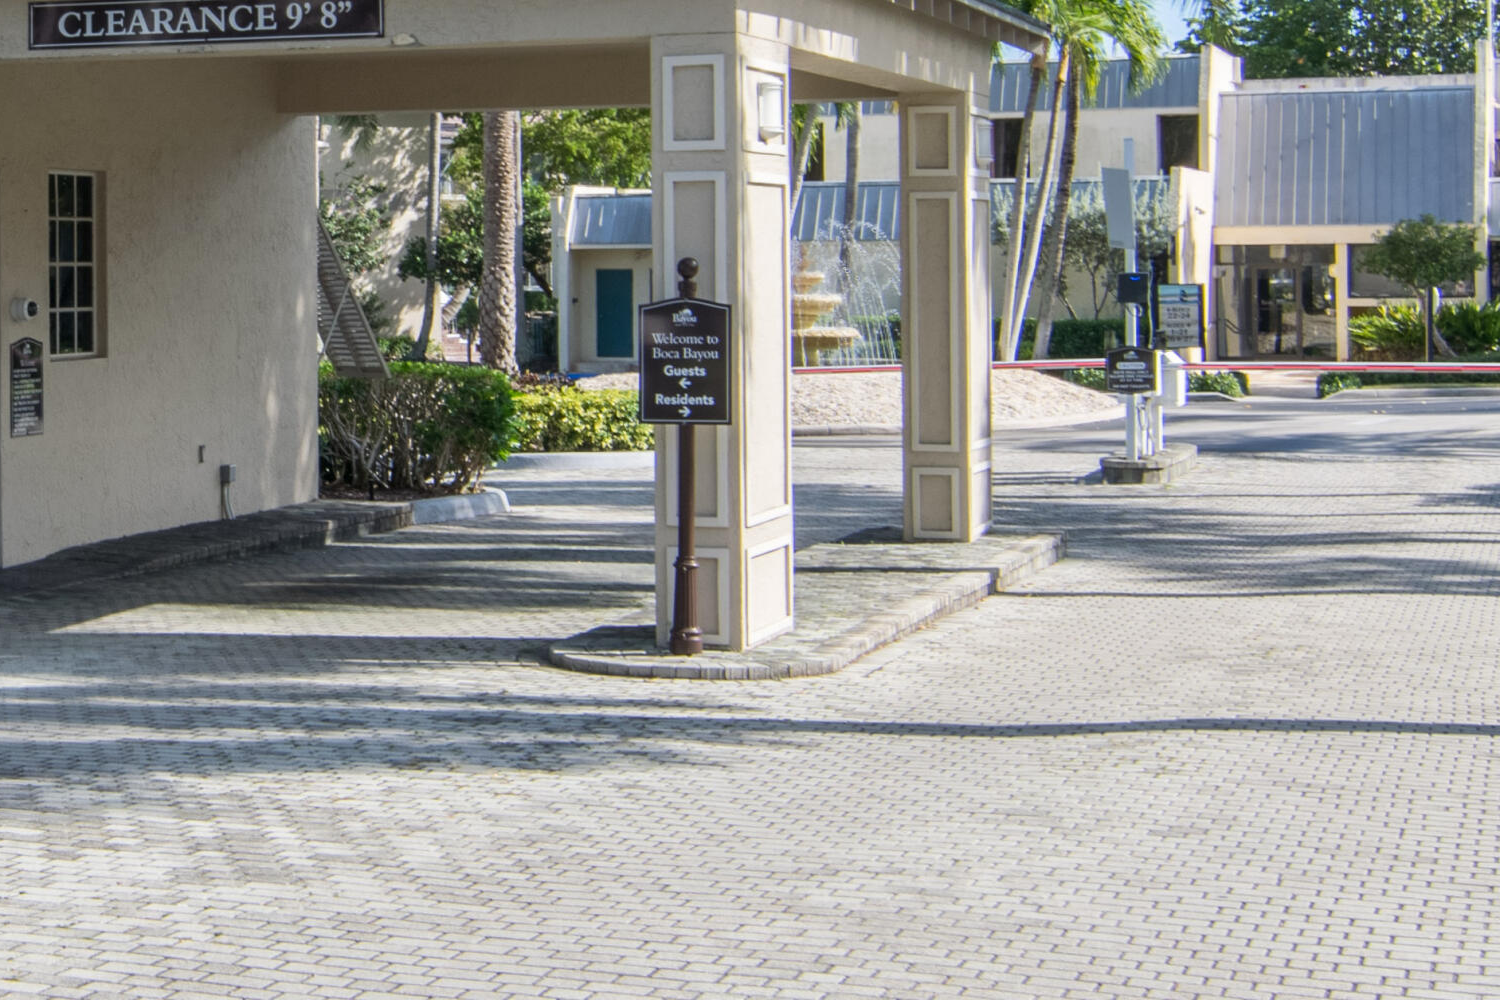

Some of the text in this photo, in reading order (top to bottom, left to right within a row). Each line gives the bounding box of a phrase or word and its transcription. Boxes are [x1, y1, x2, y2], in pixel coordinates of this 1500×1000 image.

[58, 3, 277, 38] CLEARANCE
[672, 312, 698, 325] Bayou
[652, 332, 719, 345] Welcome to
[652, 347, 719, 362] Boca Bayou
[663, 365, 707, 377] Guests
[655, 393, 715, 406] Residents
